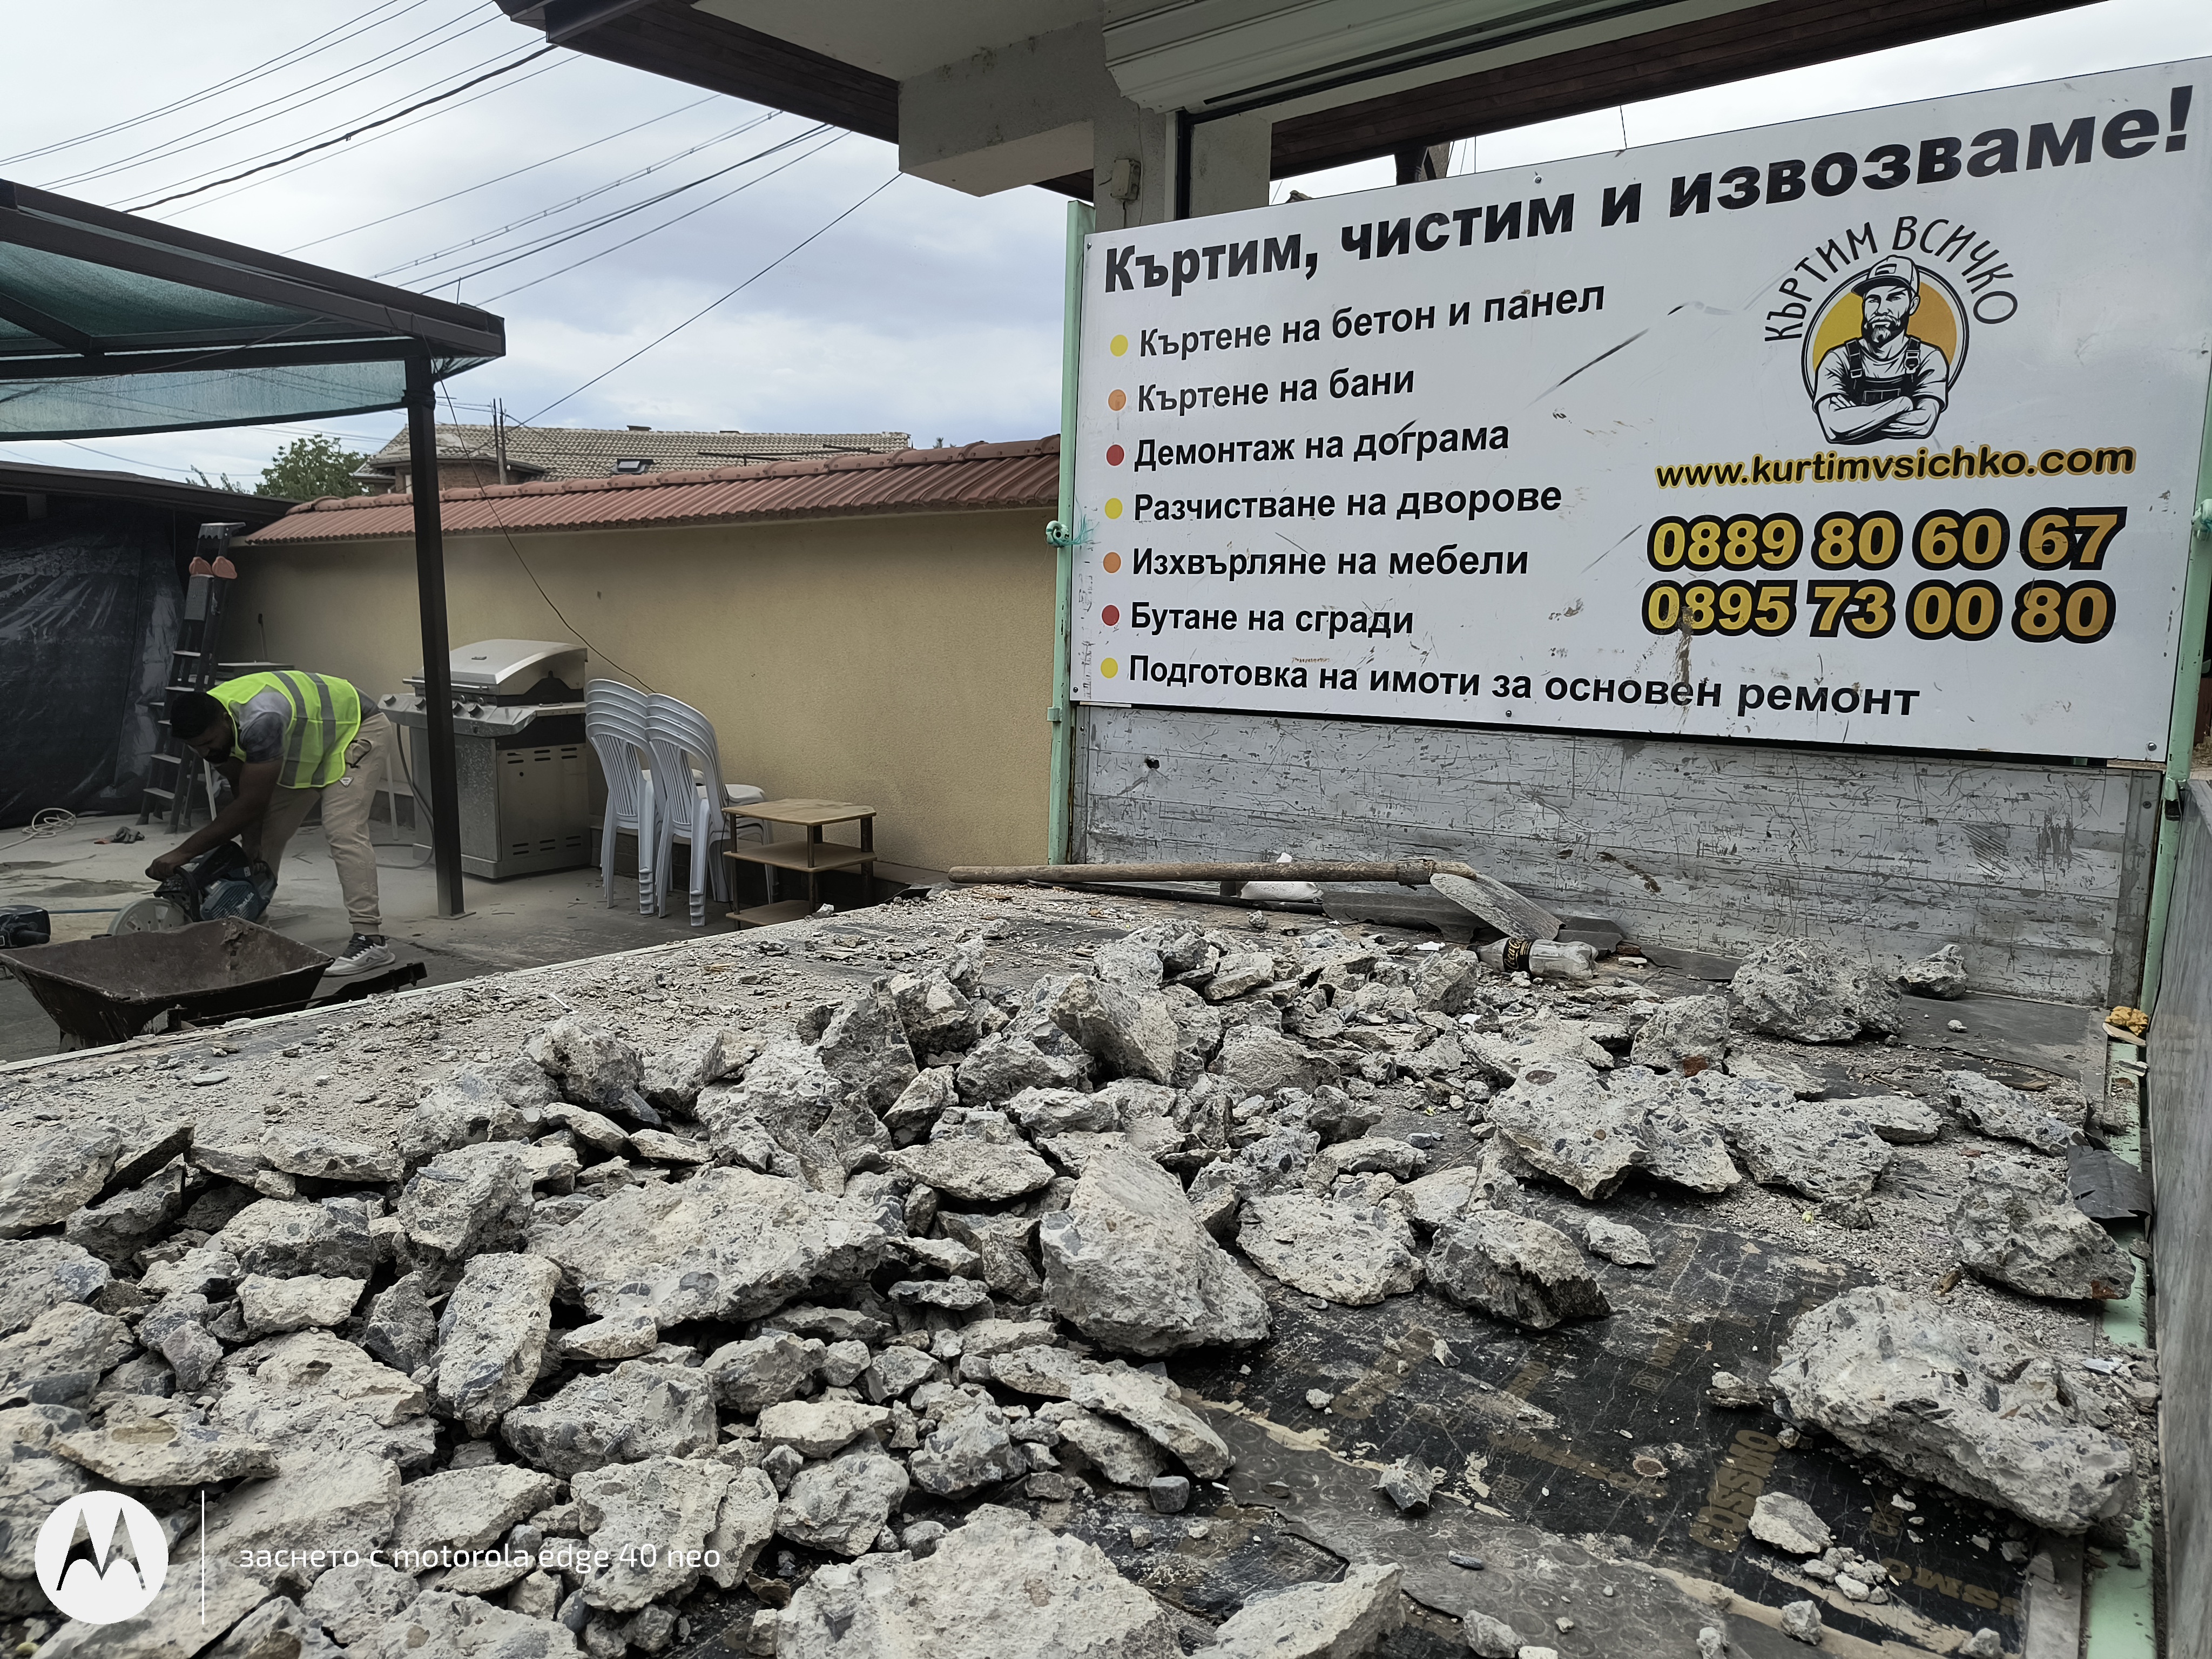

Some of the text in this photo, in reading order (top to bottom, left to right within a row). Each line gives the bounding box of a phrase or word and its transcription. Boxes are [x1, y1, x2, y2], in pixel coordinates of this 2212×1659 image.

[1105, 85, 2193, 296] Къртим, чистим и извозваме!
[1765, 216, 2018, 342] КЪРТИМ ВСИЧКО
[1141, 286, 1604, 360] Къртене на бетон и панел
[1139, 368, 1413, 416] Къртене на бани
[1135, 426, 1508, 471] Демонтаж на дограма
[1655, 445, 2135, 488] www.kurtimvsichko.com
[1135, 487, 1561, 520] Разчистване на дворове
[1134, 544, 1527, 581] Изхвърляне на мебели
[1647, 507, 2127, 572] 0889 80 60 67
[1132, 602, 1413, 639] Бутане на сгради
[1642, 579, 2116, 644] 0895 73 00 80
[1130, 655, 1920, 717] Подготовка на имоти за основен ремонт
